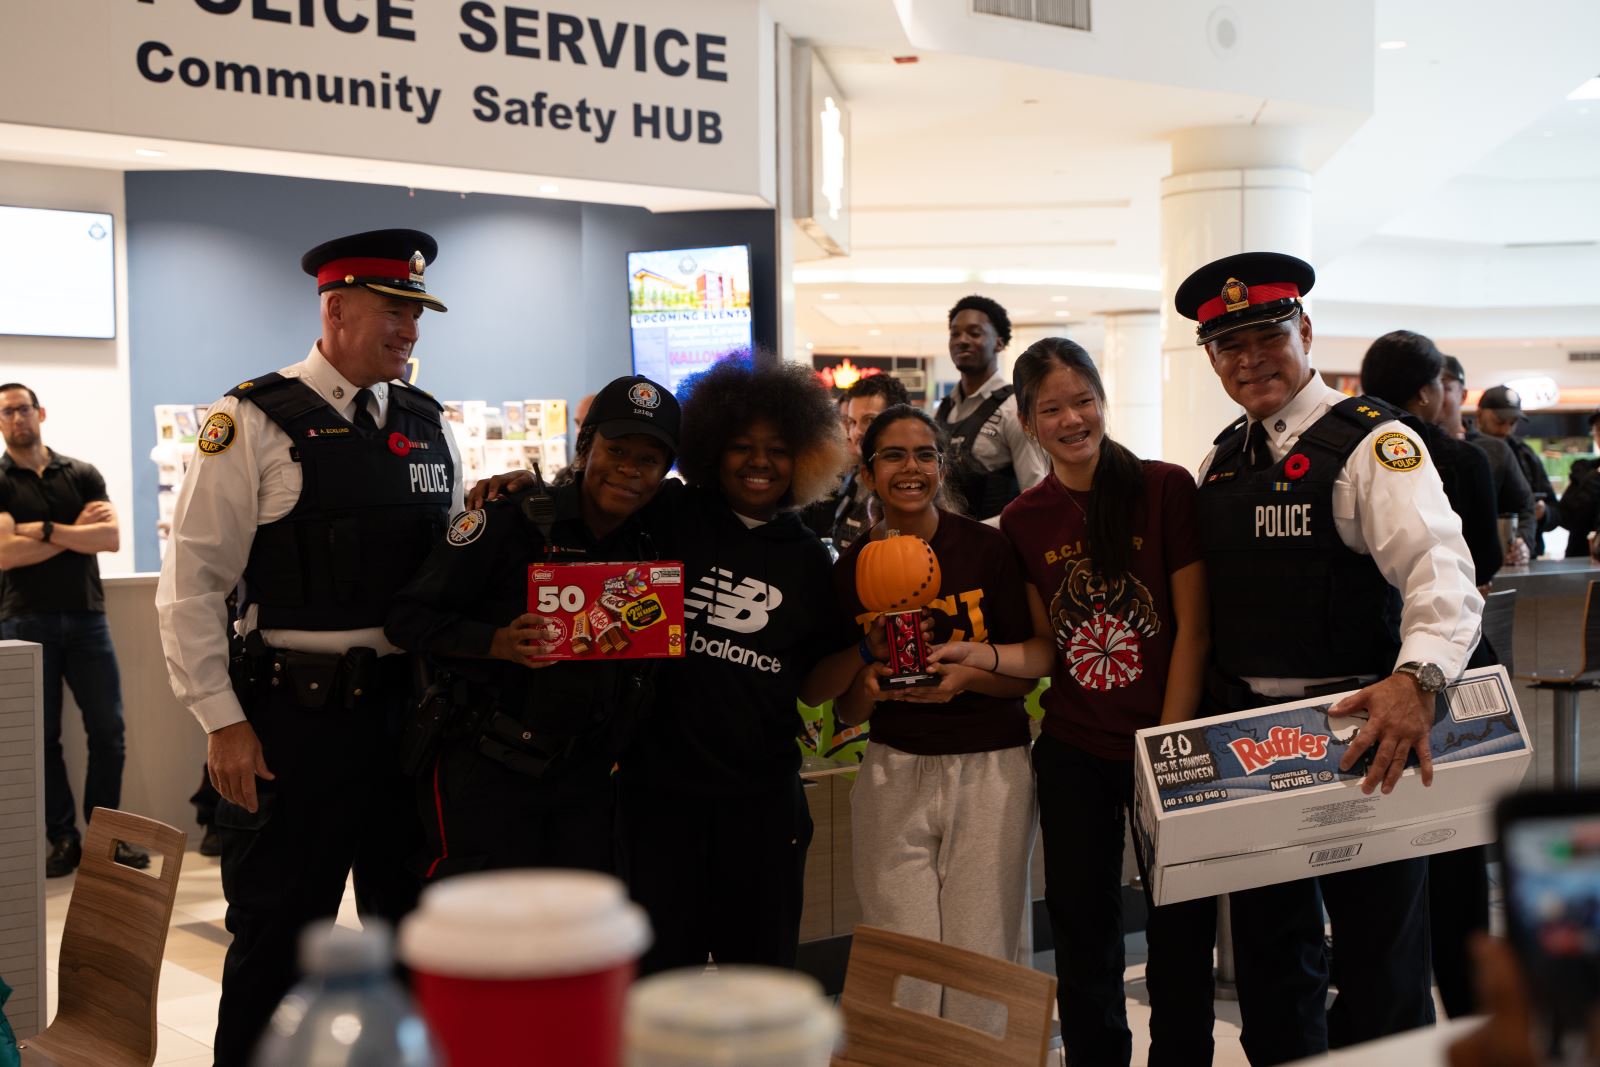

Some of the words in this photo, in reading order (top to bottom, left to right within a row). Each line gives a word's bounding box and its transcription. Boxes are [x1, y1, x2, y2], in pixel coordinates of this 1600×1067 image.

[138, 0, 416, 41] LICE
[459, 0, 728, 82] SERVICE
[136, 41, 441, 124] Community
[473, 86, 616, 143] Safety
[633, 105, 723, 144] HUB
[636, 311, 698, 323] UPCOMING
[704, 310, 747, 320] EVENTS
[1377, 433, 1408, 443] TORONTO
[1392, 457, 1416, 468] POLICE
[410, 464, 450, 493] POLICE
[1255, 504, 1312, 537] POLICE
[537, 585, 585, 613] 50
[690, 631, 782, 673] balance
[1160, 734, 1192, 758] 40
[1227, 726, 1330, 776] Ruffles
[1154, 761, 1168, 774] SACS
[1169, 760, 1178, 770] DE
[1179, 753, 1211, 769] FRIANDISES
[1271, 769, 1308, 780] CROUSTILLES
[1157, 765, 1214, 785] D'HALLOWEEN
[1271, 775, 1313, 790] NATURE
[1163, 797, 1176, 808] (40
[1195, 793, 1203, 802] g)
[1204, 790, 1219, 799] 640
[1220, 789, 1226, 798] g
